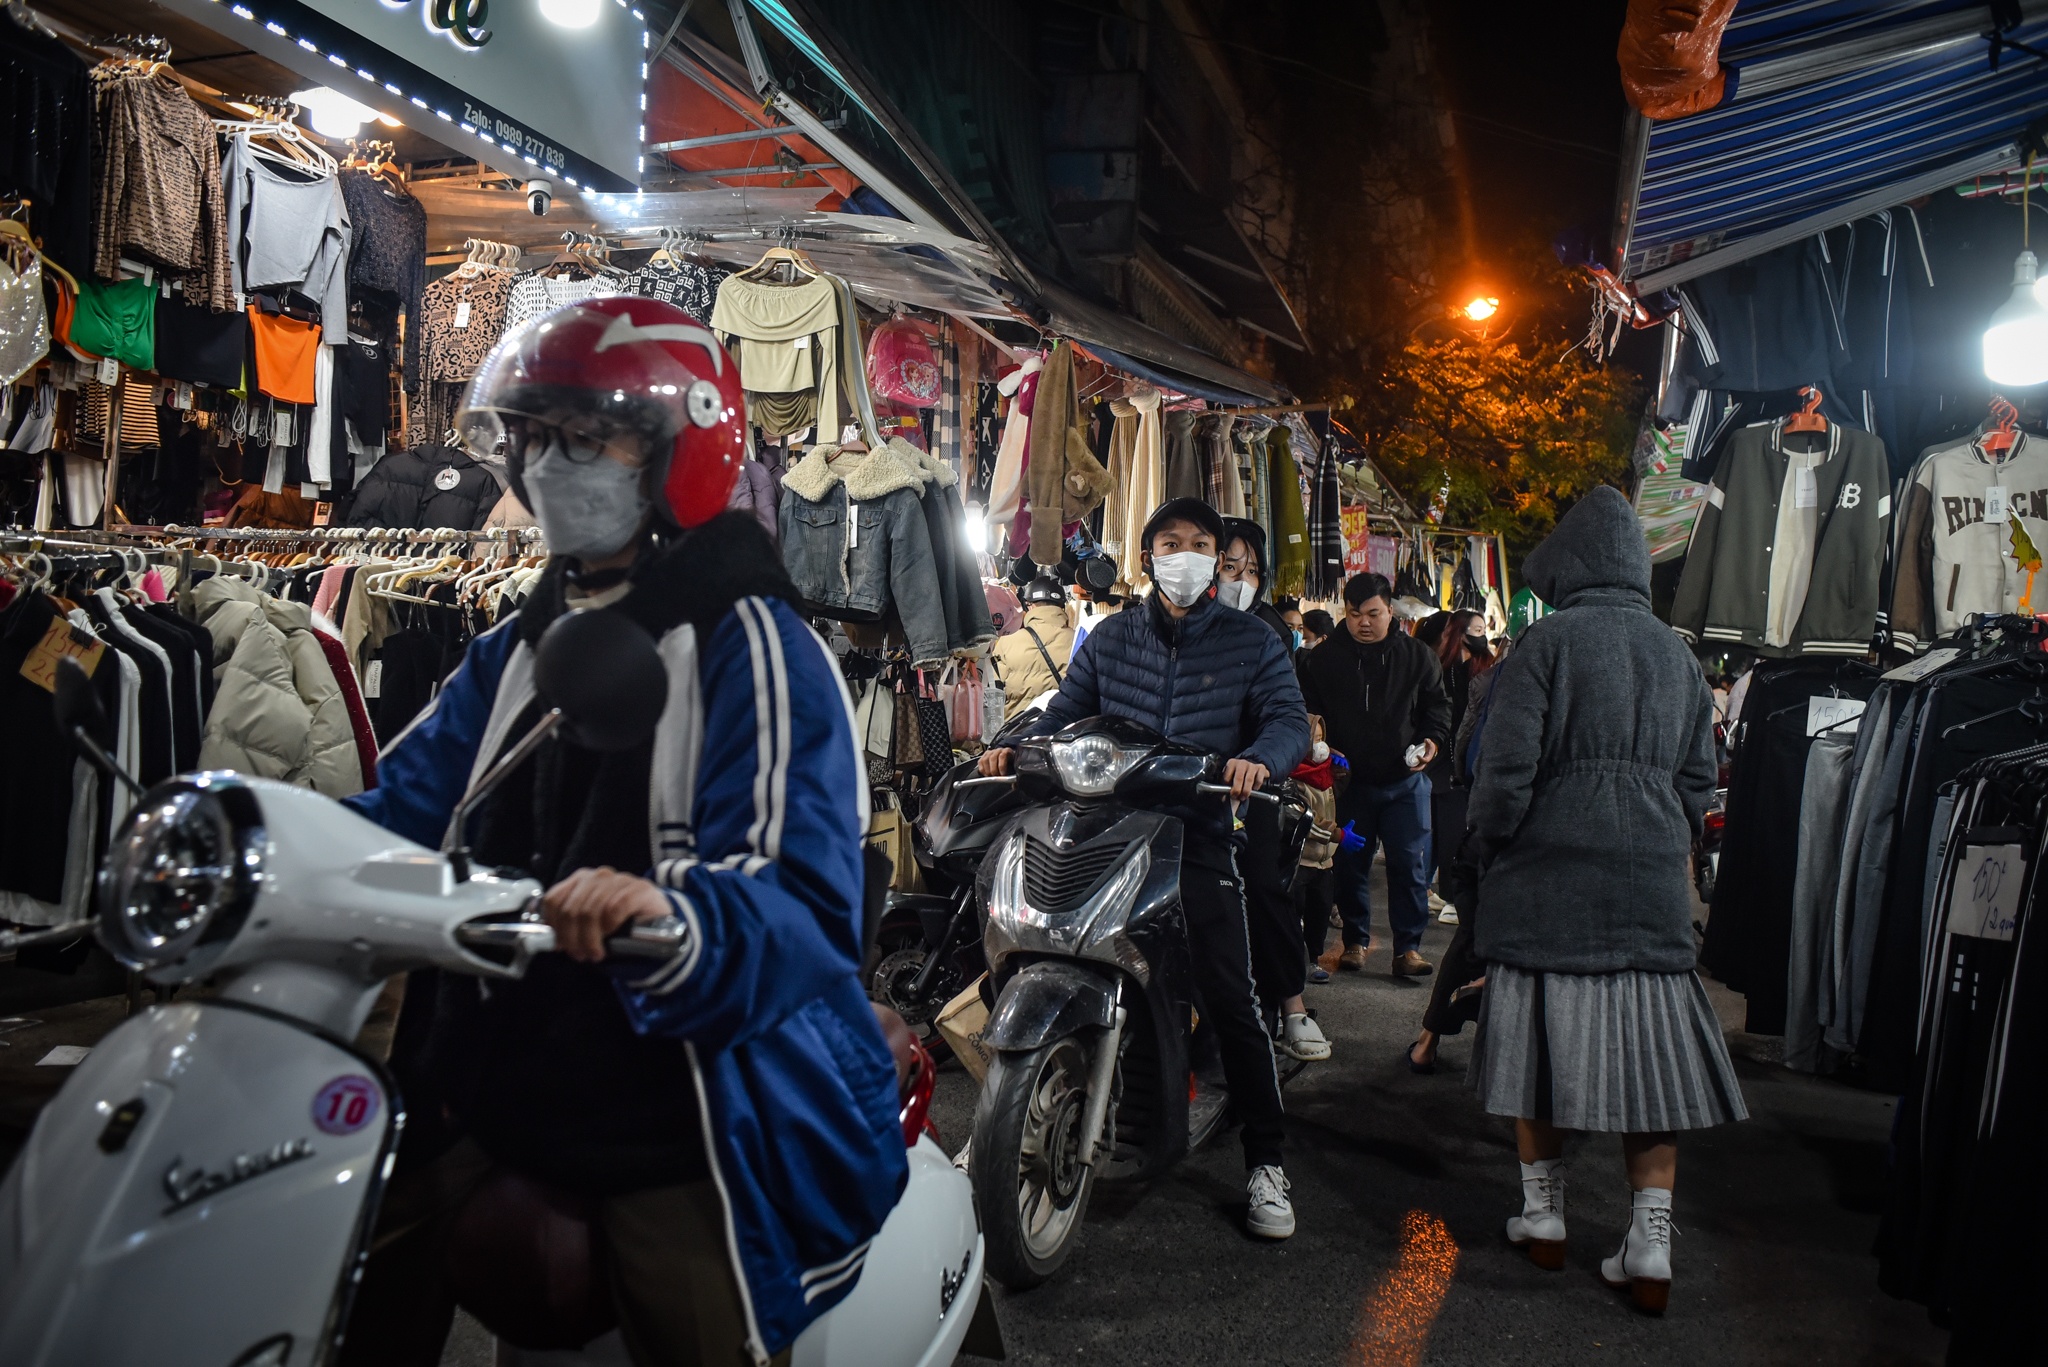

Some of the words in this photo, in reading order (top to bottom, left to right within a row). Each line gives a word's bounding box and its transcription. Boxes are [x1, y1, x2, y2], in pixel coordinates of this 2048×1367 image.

[463, 102, 492, 131] Zalo:
[495, 119, 523, 148] 0989
[525, 137, 545, 156] 277
[546, 145, 565, 170] 838
[1376, 549, 1397, 577] 50K
[327, 1092, 369, 1126] 10
